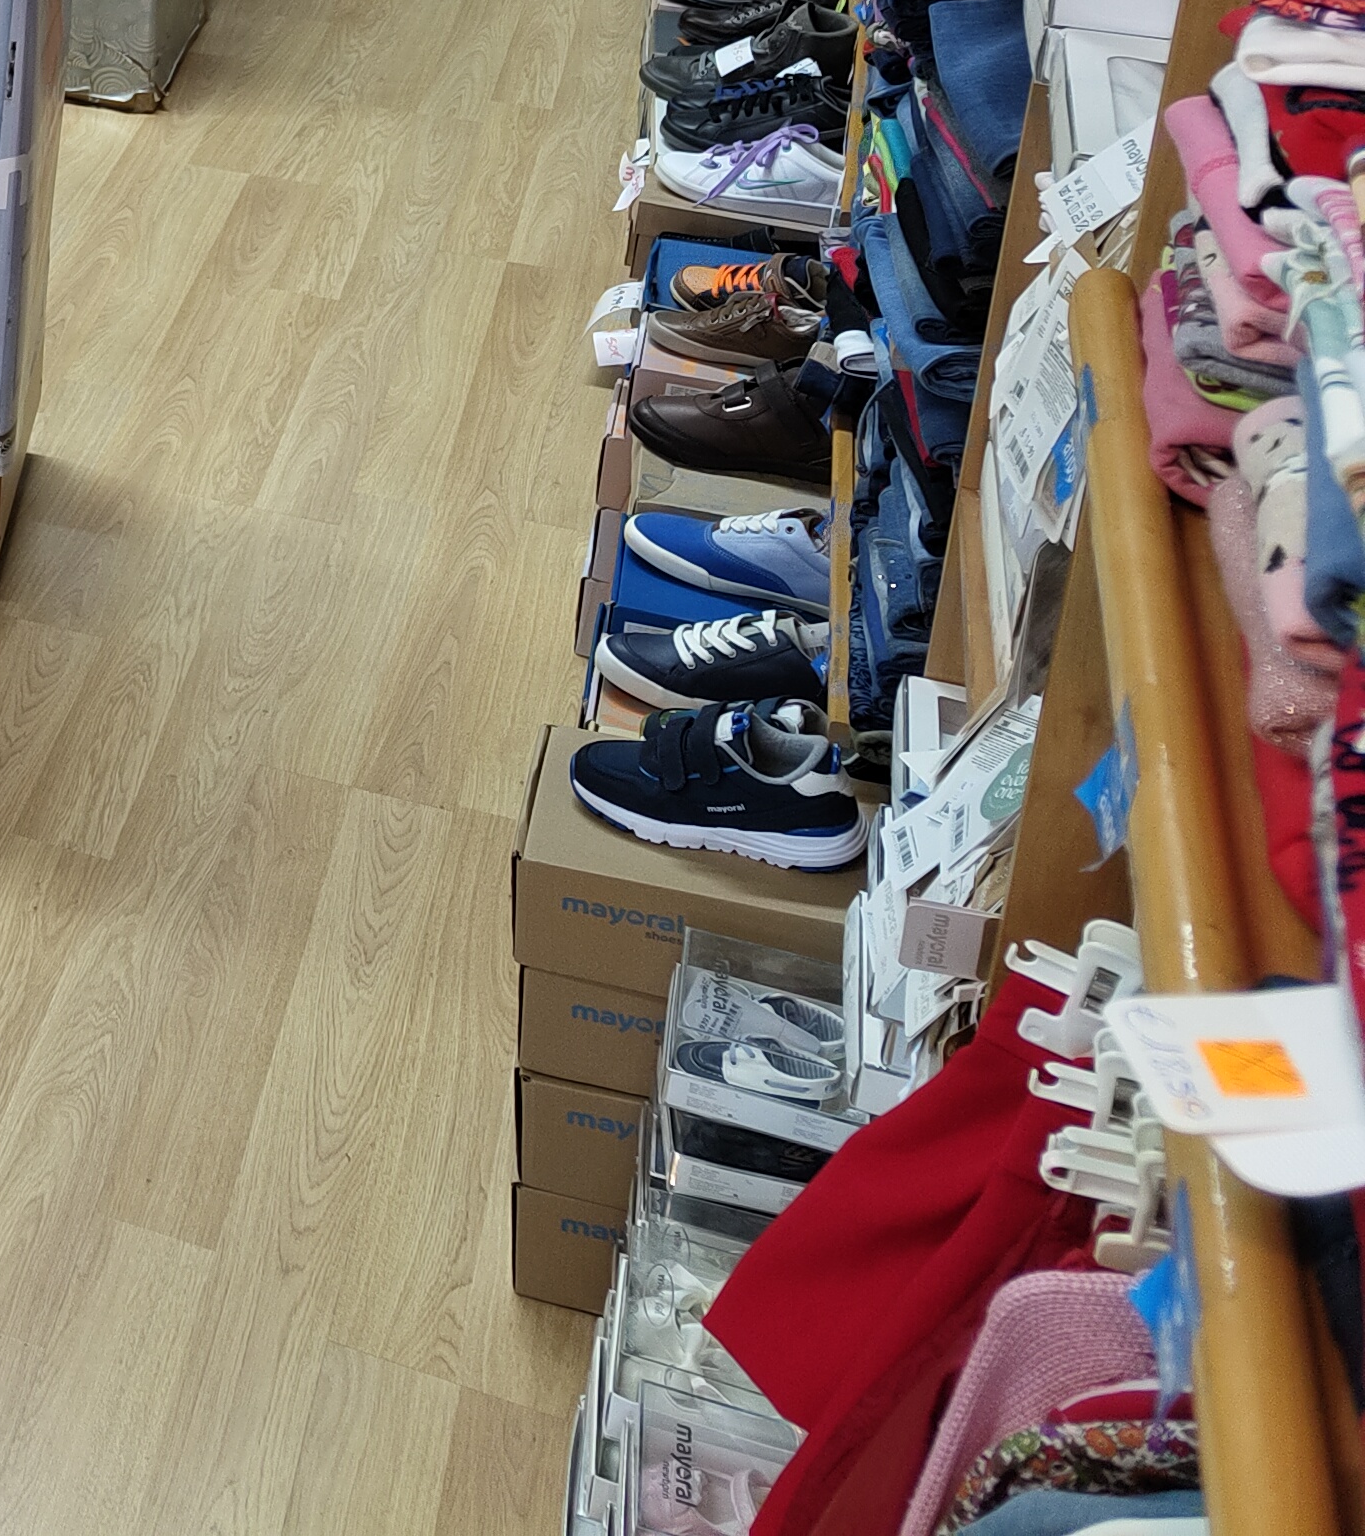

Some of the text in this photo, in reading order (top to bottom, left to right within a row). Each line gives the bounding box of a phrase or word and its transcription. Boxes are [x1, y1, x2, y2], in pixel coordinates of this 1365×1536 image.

[706, 803, 746, 814] mayoral
[561, 895, 686, 934] mayoral
[645, 931, 683, 946] shoes
[926, 913, 951, 970] mayoral
[570, 1003, 666, 1036] mayor
[675, 1423, 698, 1509] mayoral
